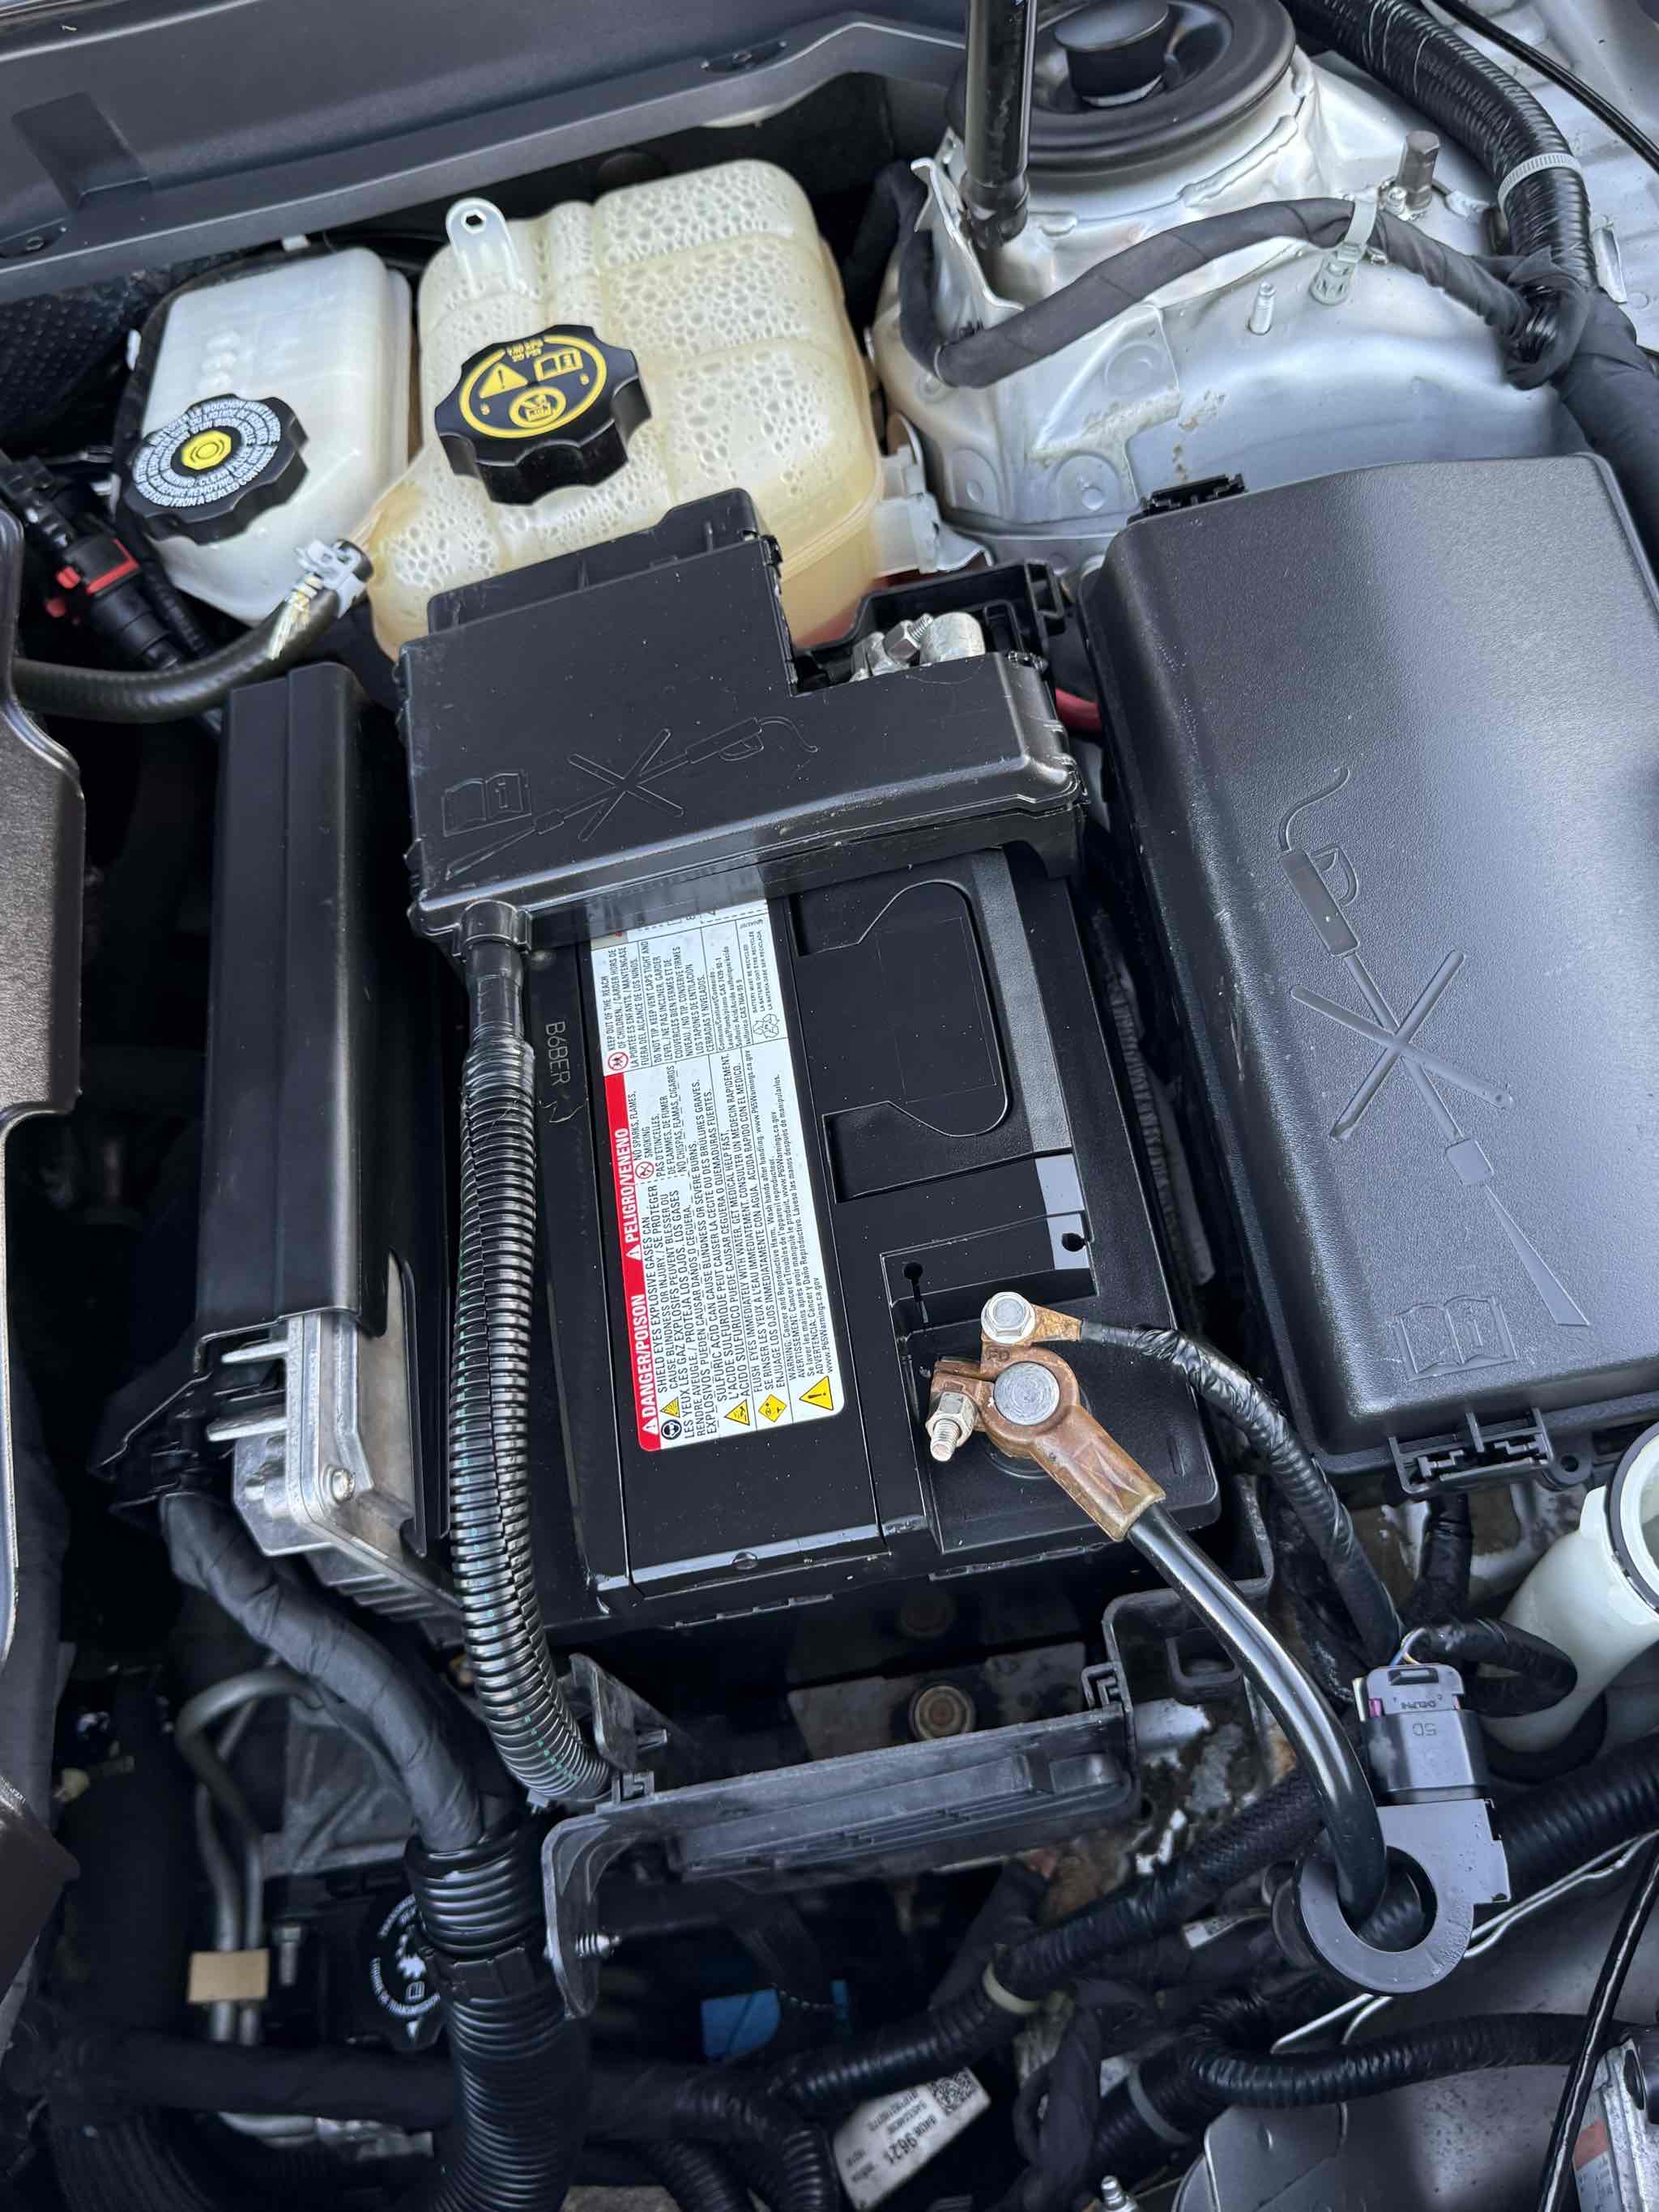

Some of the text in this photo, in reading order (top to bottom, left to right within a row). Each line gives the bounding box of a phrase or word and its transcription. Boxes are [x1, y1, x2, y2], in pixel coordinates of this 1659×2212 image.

[187, 474, 235, 499] REMOVING
[200, 469, 231, 487] CLEAN
[205, 481, 240, 502] SEALED
[546, 1021, 571, 1086] B6BER
[667, 1066, 677, 1097] CIGARROS
[659, 1096, 670, 1119] FUMER
[692, 1080, 703, 1112] GRAVES.
[704, 1089, 715, 1126] FUERTES.
[738, 1096, 745, 1104] EL
[662, 1120, 670, 1128] DE
[739, 1106, 748, 1122] CON
[632, 1150, 642, 1161] NO
[642, 1127, 653, 1158] SMOKING
[732, 1141, 741, 1152] UN
[655, 1161, 665, 1177] PAS
[676, 1161, 687, 1172] NO
[702, 1158, 710, 1174] DES
[709, 1127, 723, 1185] QUEMADURAS
[723, 1153, 733, 1170] HELP
[745, 1153, 757, 1179] ACUDA
[667, 1166, 676, 1174] DE
[703, 1177, 712, 1188] OU
[735, 1153, 748, 1198] CONSULTER
[614, 1127, 640, 1243] PELIGRO/VENENO
[726, 1172, 738, 1208] MEDICAL
[750, 1186, 760, 1208] AGUA.
[669, 1191, 681, 1221] GASES
[718, 1196, 729, 1234] CEGUERA
[731, 1210, 740, 1224] GET
[753, 1211, 762, 1227] CON
[673, 1225, 684, 1242] LOS
[683, 1205, 695, 1246] CEGUERA.
[709, 1221, 718, 1231] LA
[654, 1236, 663, 1248] SE
[710, 1234, 723, 1267] CAUSER
[723, 1237, 734, 1271] CAUSAR
[676, 1245, 687, 1273] OJOS.
[689, 1141, 727, 1401] SULFURIC ACID CAN CAUSE BLINDNESS OR SEVERE BURNS.
[737, 1258, 748, 1280] WITH
[756, 1230, 773, 1302] INMEDIATAMENTE
[679, 1276, 689, 1294] LOS
[715, 1270, 726, 1291] PEUT
[727, 1274, 738, 1302] PUEDE
[750, 1272, 761, 1295] L'EAU
[642, 1217, 667, 1393] SHIELD EYES EXPLOSIVE GASES CAN
[660, 1291, 669, 1302] OR
[693, 1289, 704, 1326] CAUSAR
[660, 1194, 694, 1438] LES YEUX LES GAZ EXPLOSIFS PEUVENT BLESSER OU
[681, 1297, 695, 1343] PROTEJA
[740, 1283, 755, 1338] IMMEDIATELY
[755, 1305, 765, 1328] YEUX
[766, 1305, 777, 1327] OJOS
[662, 1306, 674, 1356] BLINDNESS
[717, 1294, 733, 1357] SULFURIQUE
[757, 1329, 767, 1344] LES
[769, 1329, 778, 1345] LOS
[631, 1294, 657, 1417] DANGER/POISON
[697, 1328, 709, 1365] PUEDEN
[748, 1340, 758, 1361] EYES
[667, 1358, 678, 1389] CAUSE
[760, 1345, 772, 1377] RINSER
[771, 1348, 785, 1387] ENJUAGE
[725, 1359, 739, 1400] L'ACIDE
[751, 1366, 762, 1392] FLUSH
[765, 1379, 774, 1390] SE
[700, 1369, 717, 1434] EXPLOSIVOS
[693, 1399, 706, 1436] RENDRE
